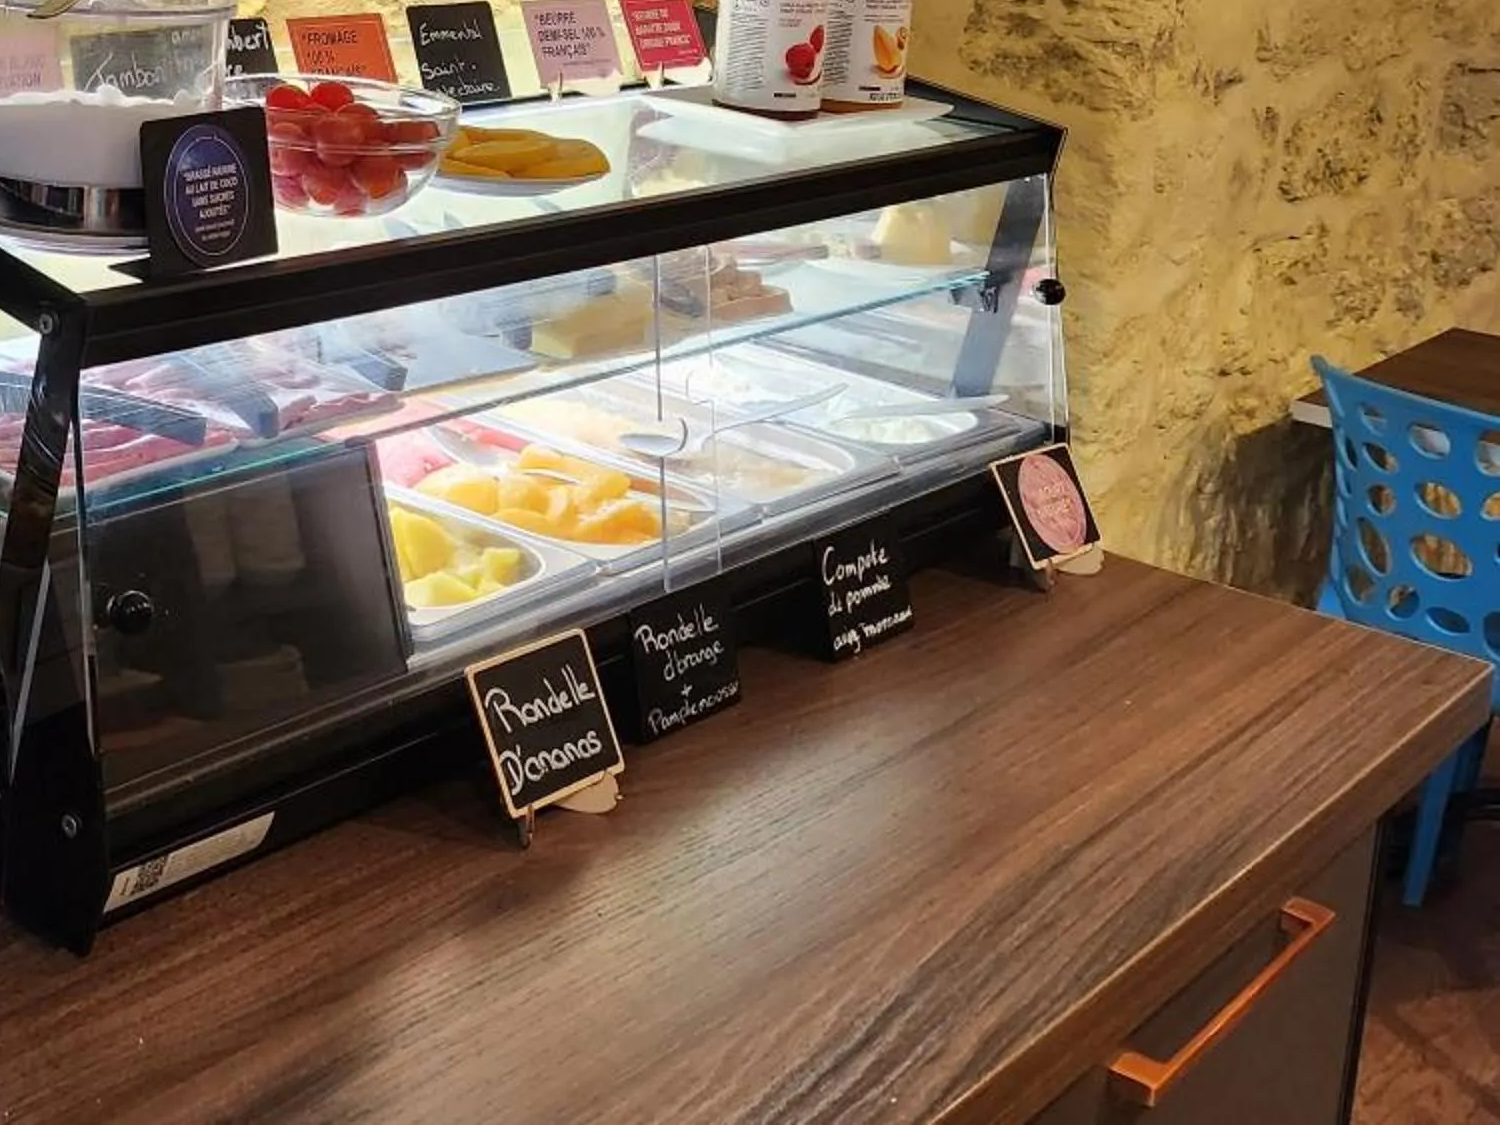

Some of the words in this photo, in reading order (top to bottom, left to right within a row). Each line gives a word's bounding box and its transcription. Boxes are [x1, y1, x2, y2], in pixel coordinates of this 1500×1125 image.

[220, 176, 239, 188] COCO
[821, 538, 891, 587] Compote
[633, 602, 720, 654] Rondelle
[484, 663, 596, 733] Rondelle
